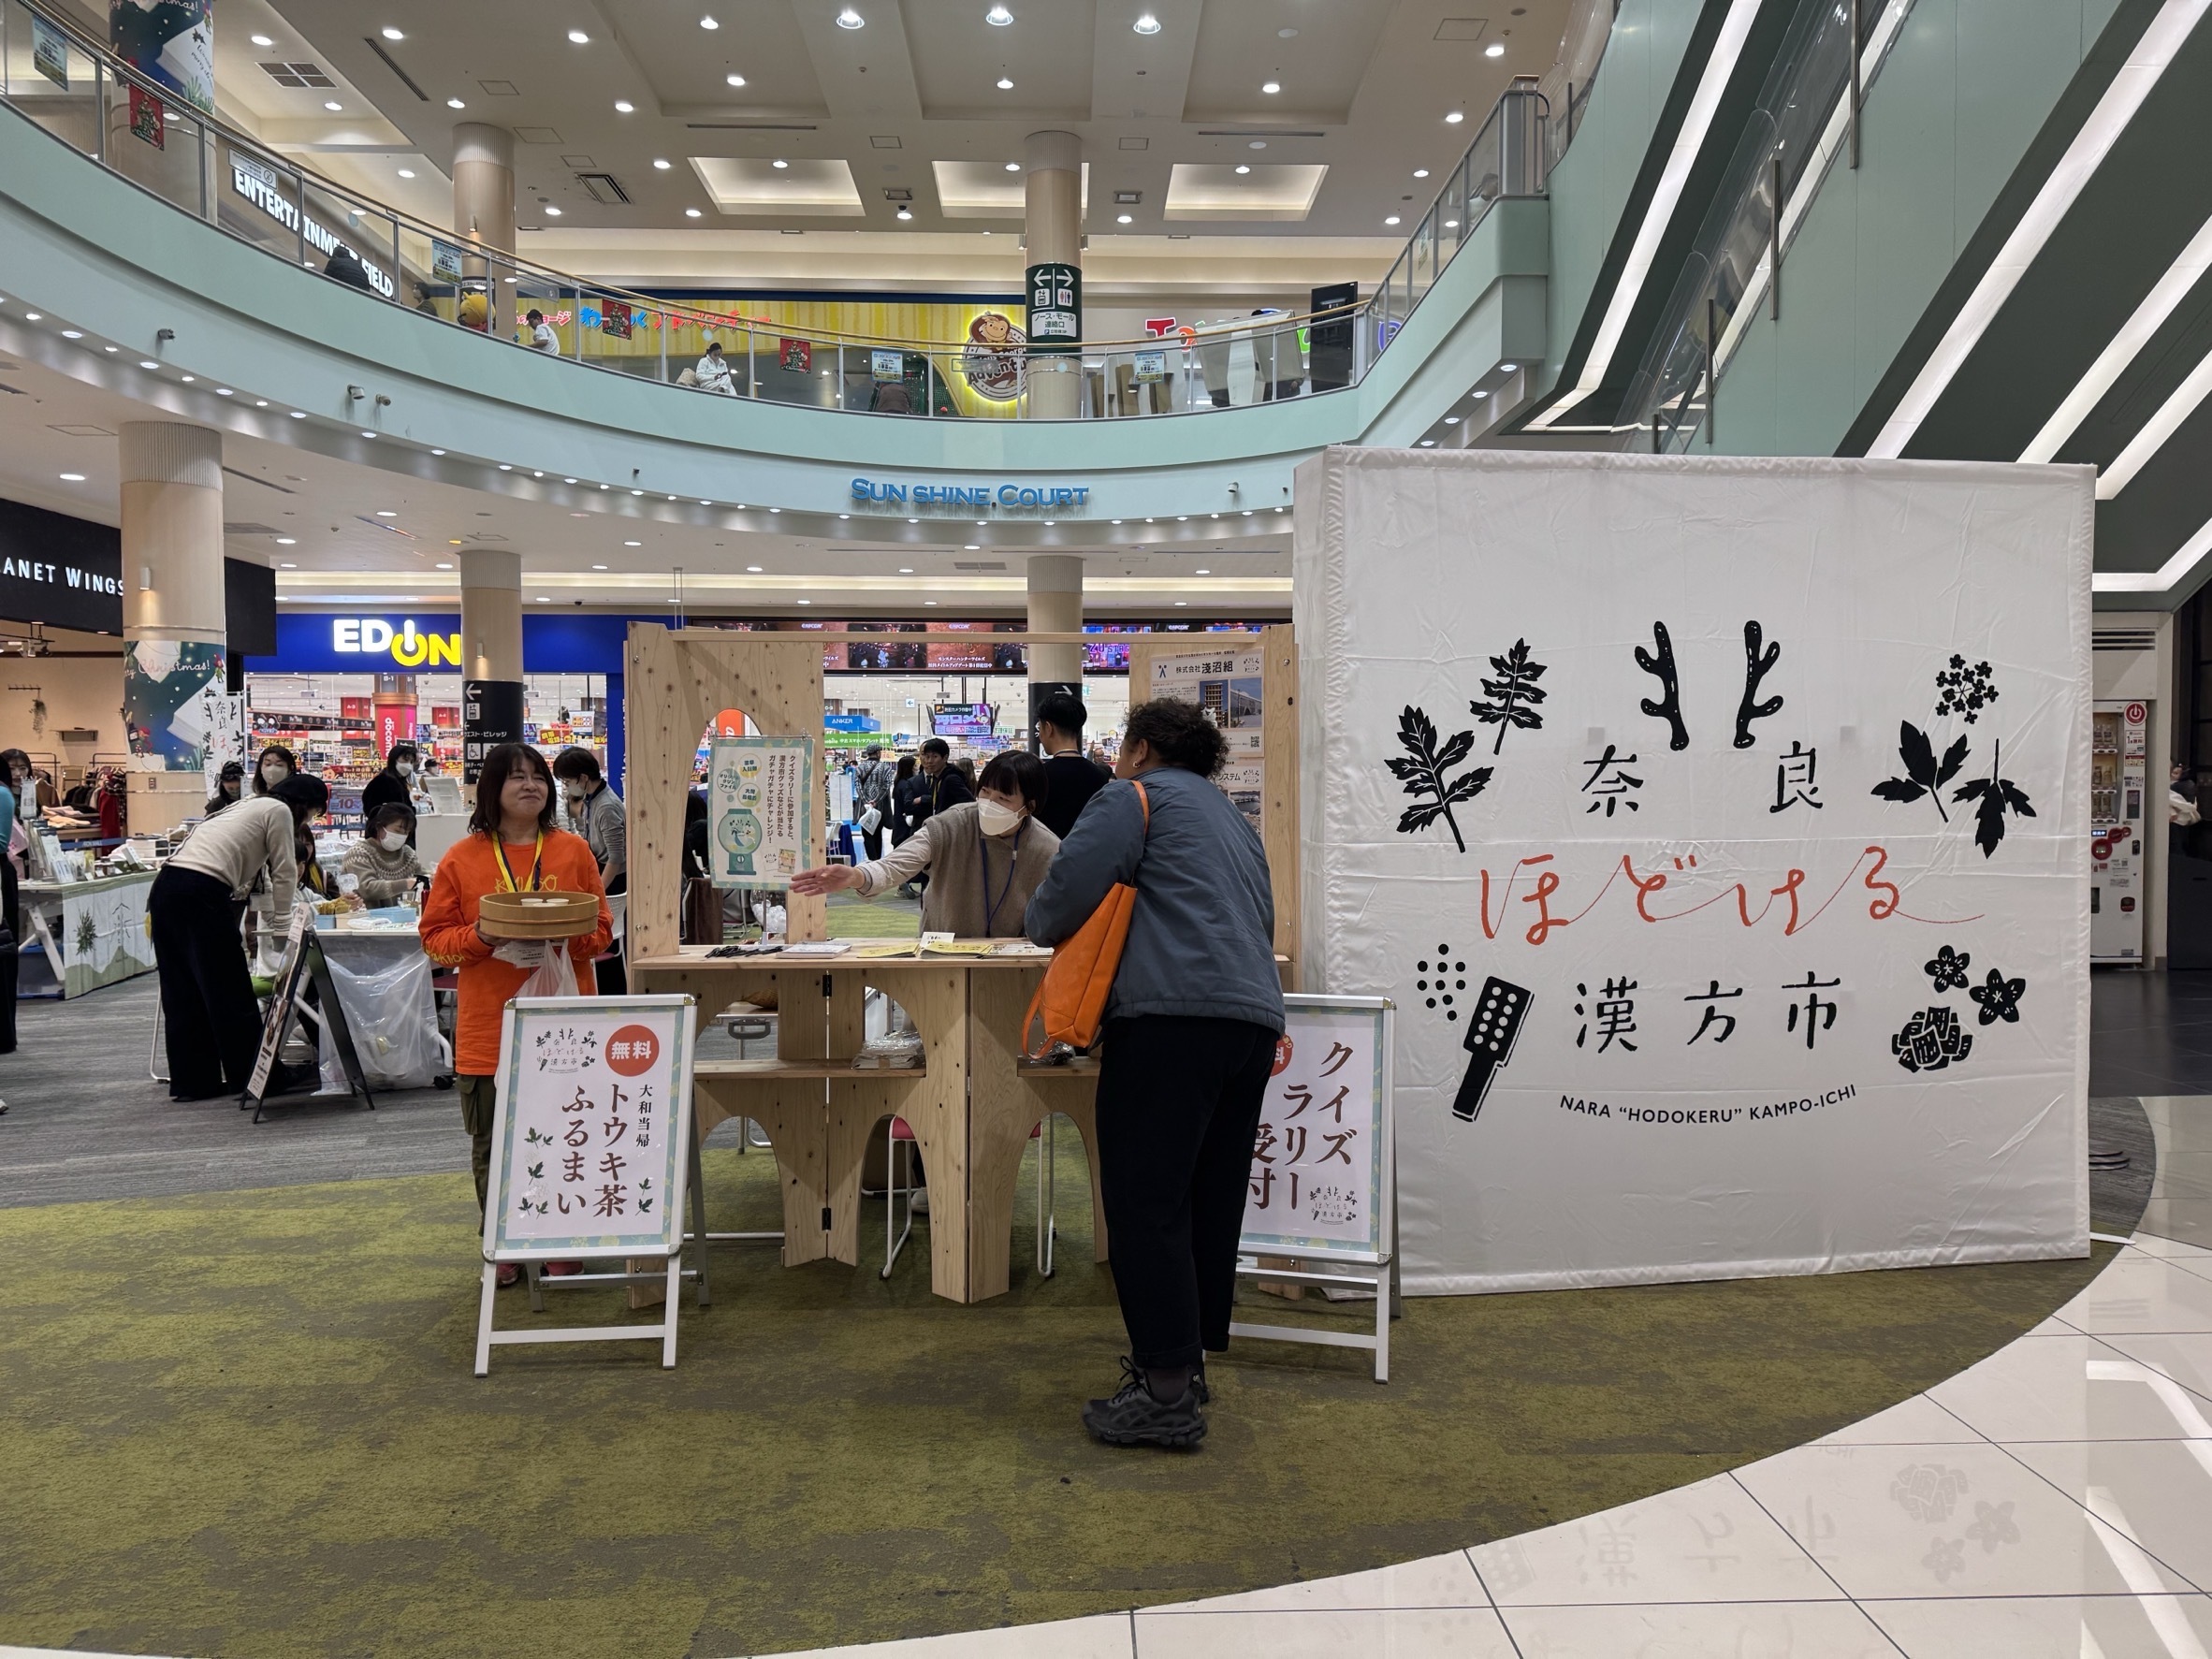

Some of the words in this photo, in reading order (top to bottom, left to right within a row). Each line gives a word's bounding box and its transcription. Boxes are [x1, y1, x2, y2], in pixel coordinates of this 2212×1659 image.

[235, 169, 358, 260] ENTERTAINMET
[0, 557, 55, 583] ANET
[65, 567, 124, 596] WINGS
[333, 619, 461, 666] EDION
[1581, 740, 1824, 817] 奈良
[1480, 846, 1985, 946] ほどける
[611, 1041, 652, 1060] 無料
[1575, 971, 1841, 1055] 漢方市
[635, 1084, 653, 1148] 大和当帰
[1315, 1041, 1358, 1166] クイズ
[1560, 1095, 1610, 1119] NARA
[1750, 1084, 1856, 1121] KAMPO-ICHI
[558, 1085, 595, 1215] ふるまい
[593, 1084, 630, 1217] トウキ茶
[1283, 1084, 1313, 1211] ラリー
